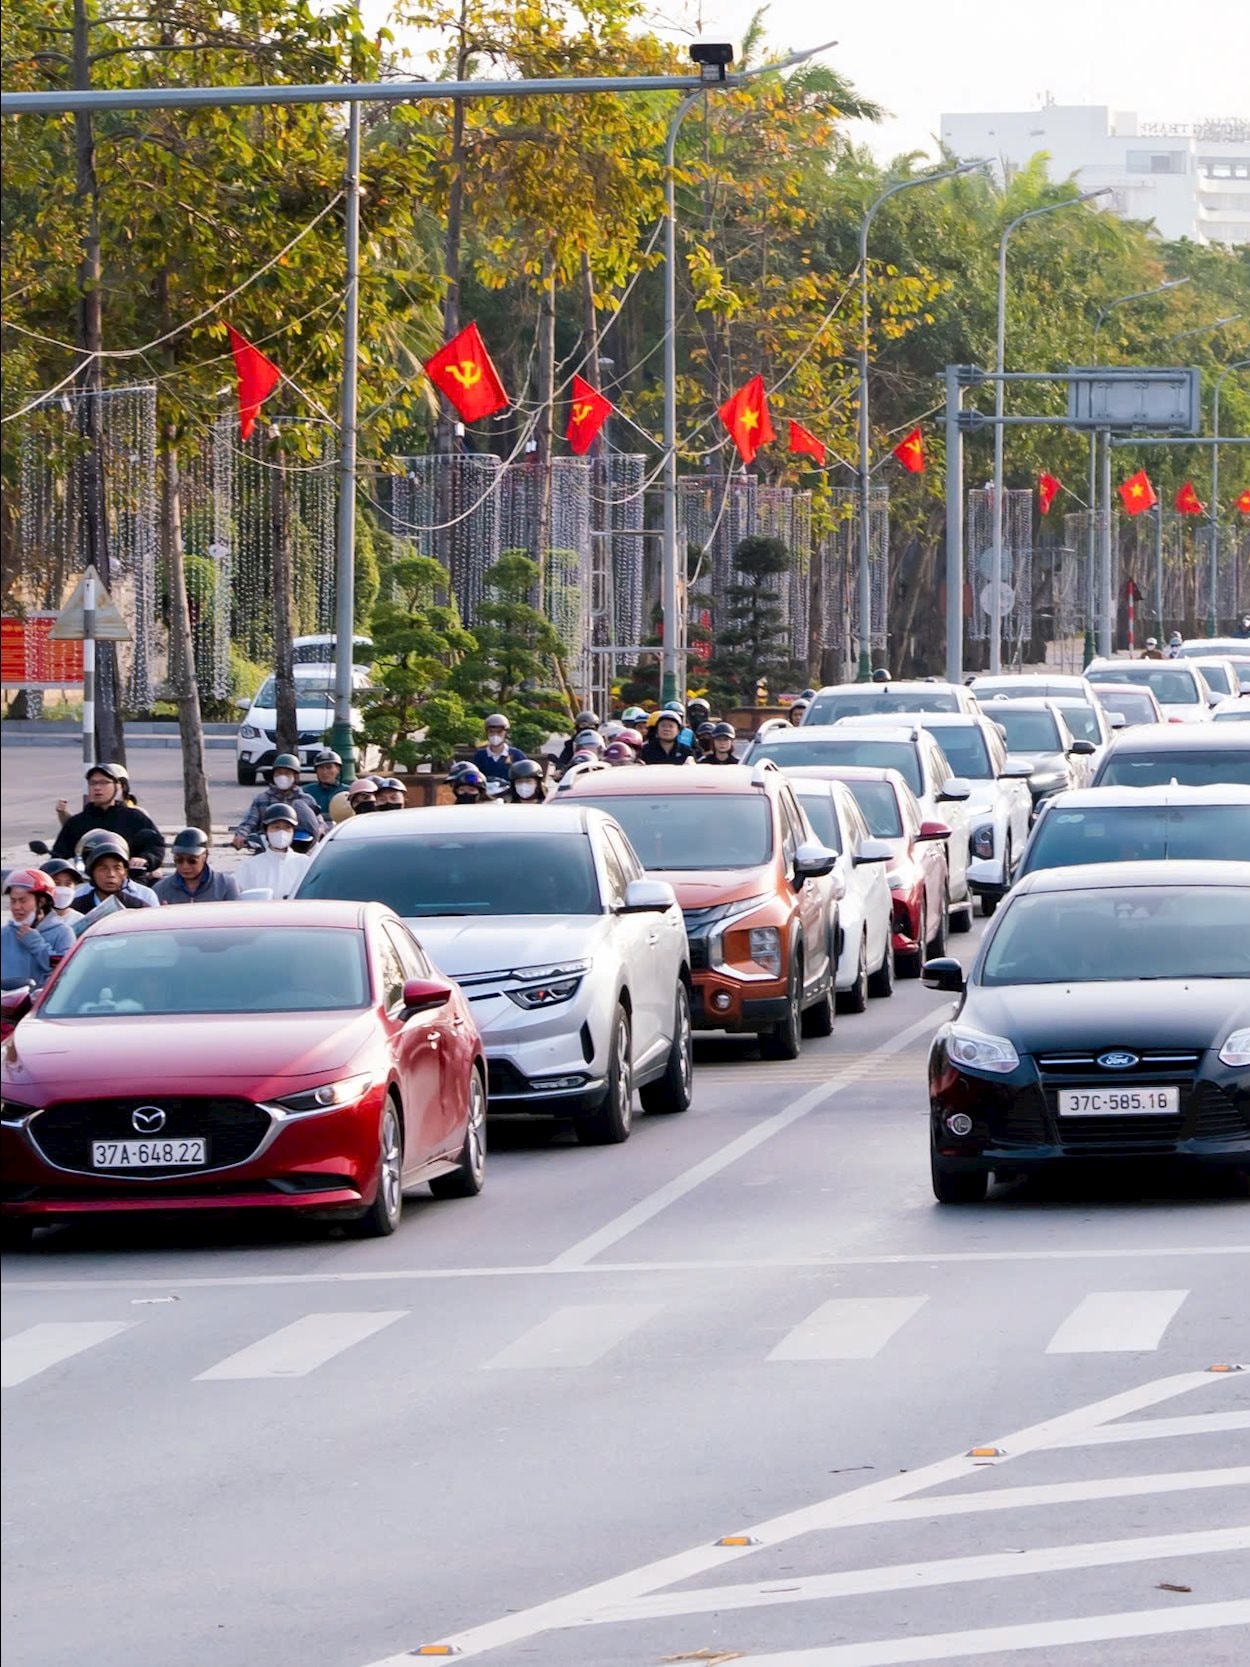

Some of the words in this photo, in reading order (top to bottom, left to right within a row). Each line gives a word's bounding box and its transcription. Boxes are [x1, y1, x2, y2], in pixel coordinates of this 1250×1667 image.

[1105, 1054, 1130, 1065] Ford
[1070, 1093, 1168, 1112] 37C-585.18
[95, 1142, 202, 1165] 37A-648.22
